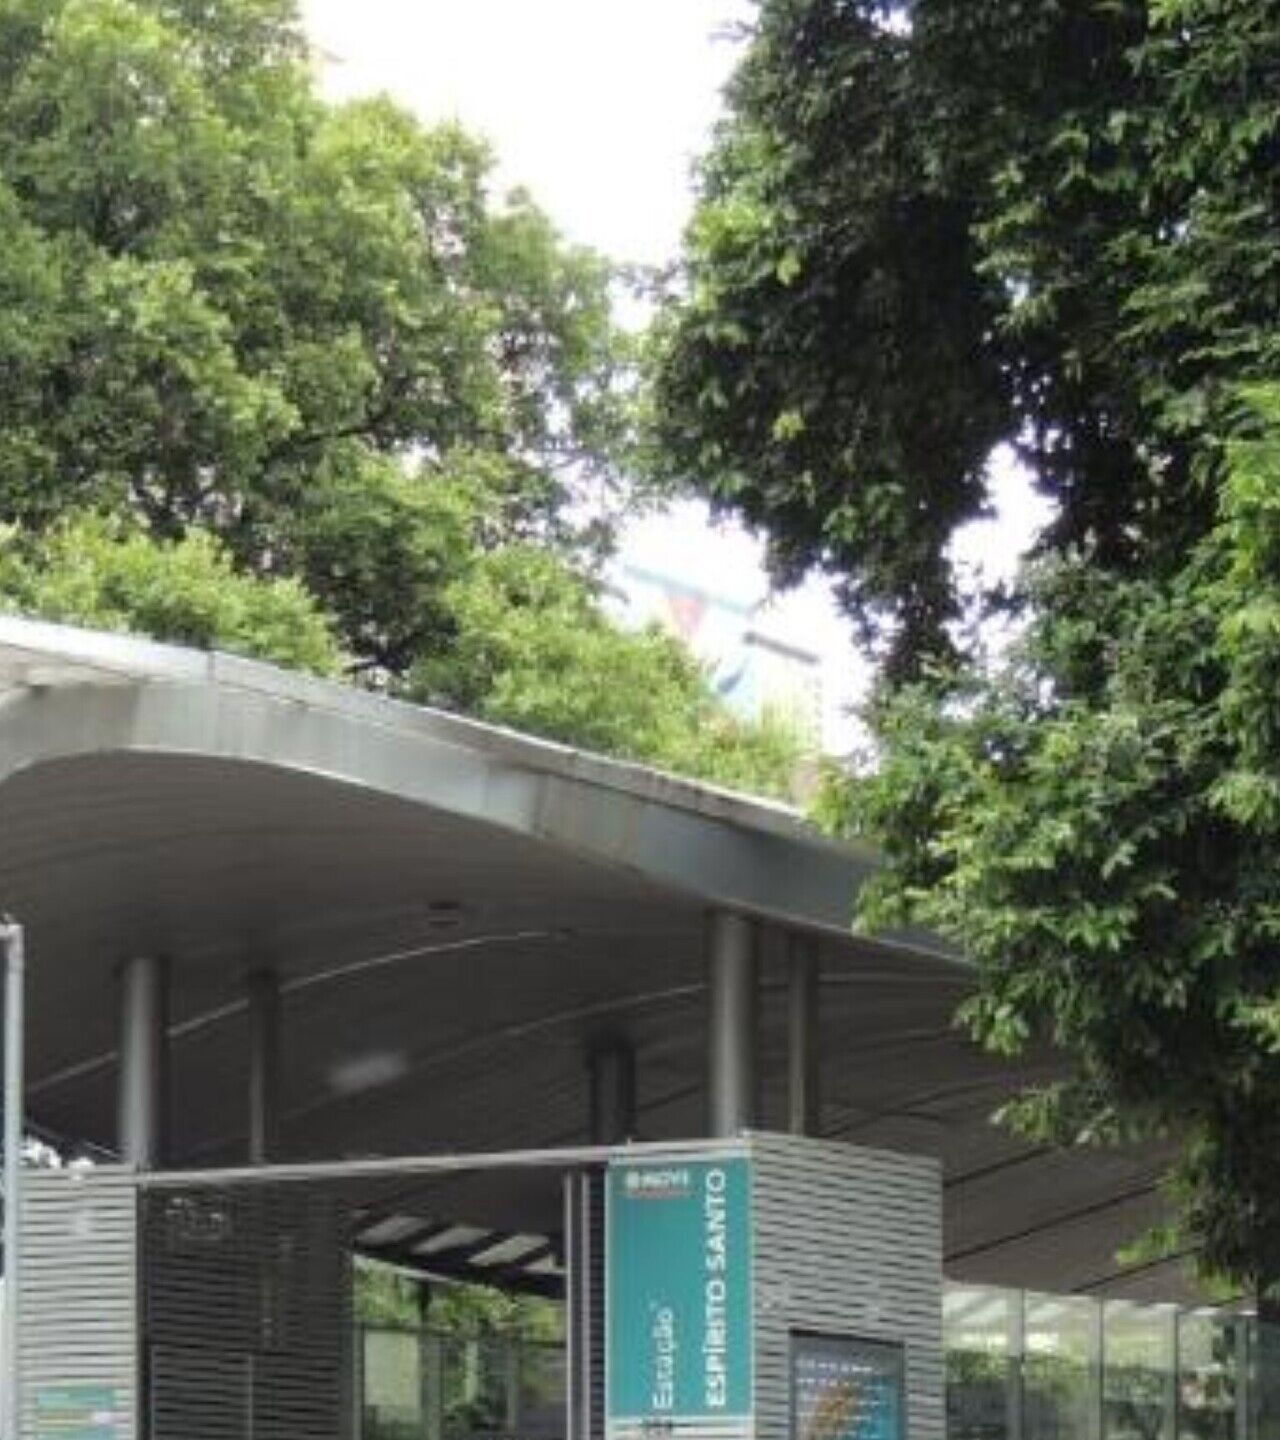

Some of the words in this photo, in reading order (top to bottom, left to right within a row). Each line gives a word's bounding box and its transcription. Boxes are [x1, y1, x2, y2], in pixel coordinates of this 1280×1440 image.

[704, 1168, 726, 1272] SANTO
[651, 1306, 678, 1410] Estação
[702, 1279, 726, 1407] ESPÍRITO
